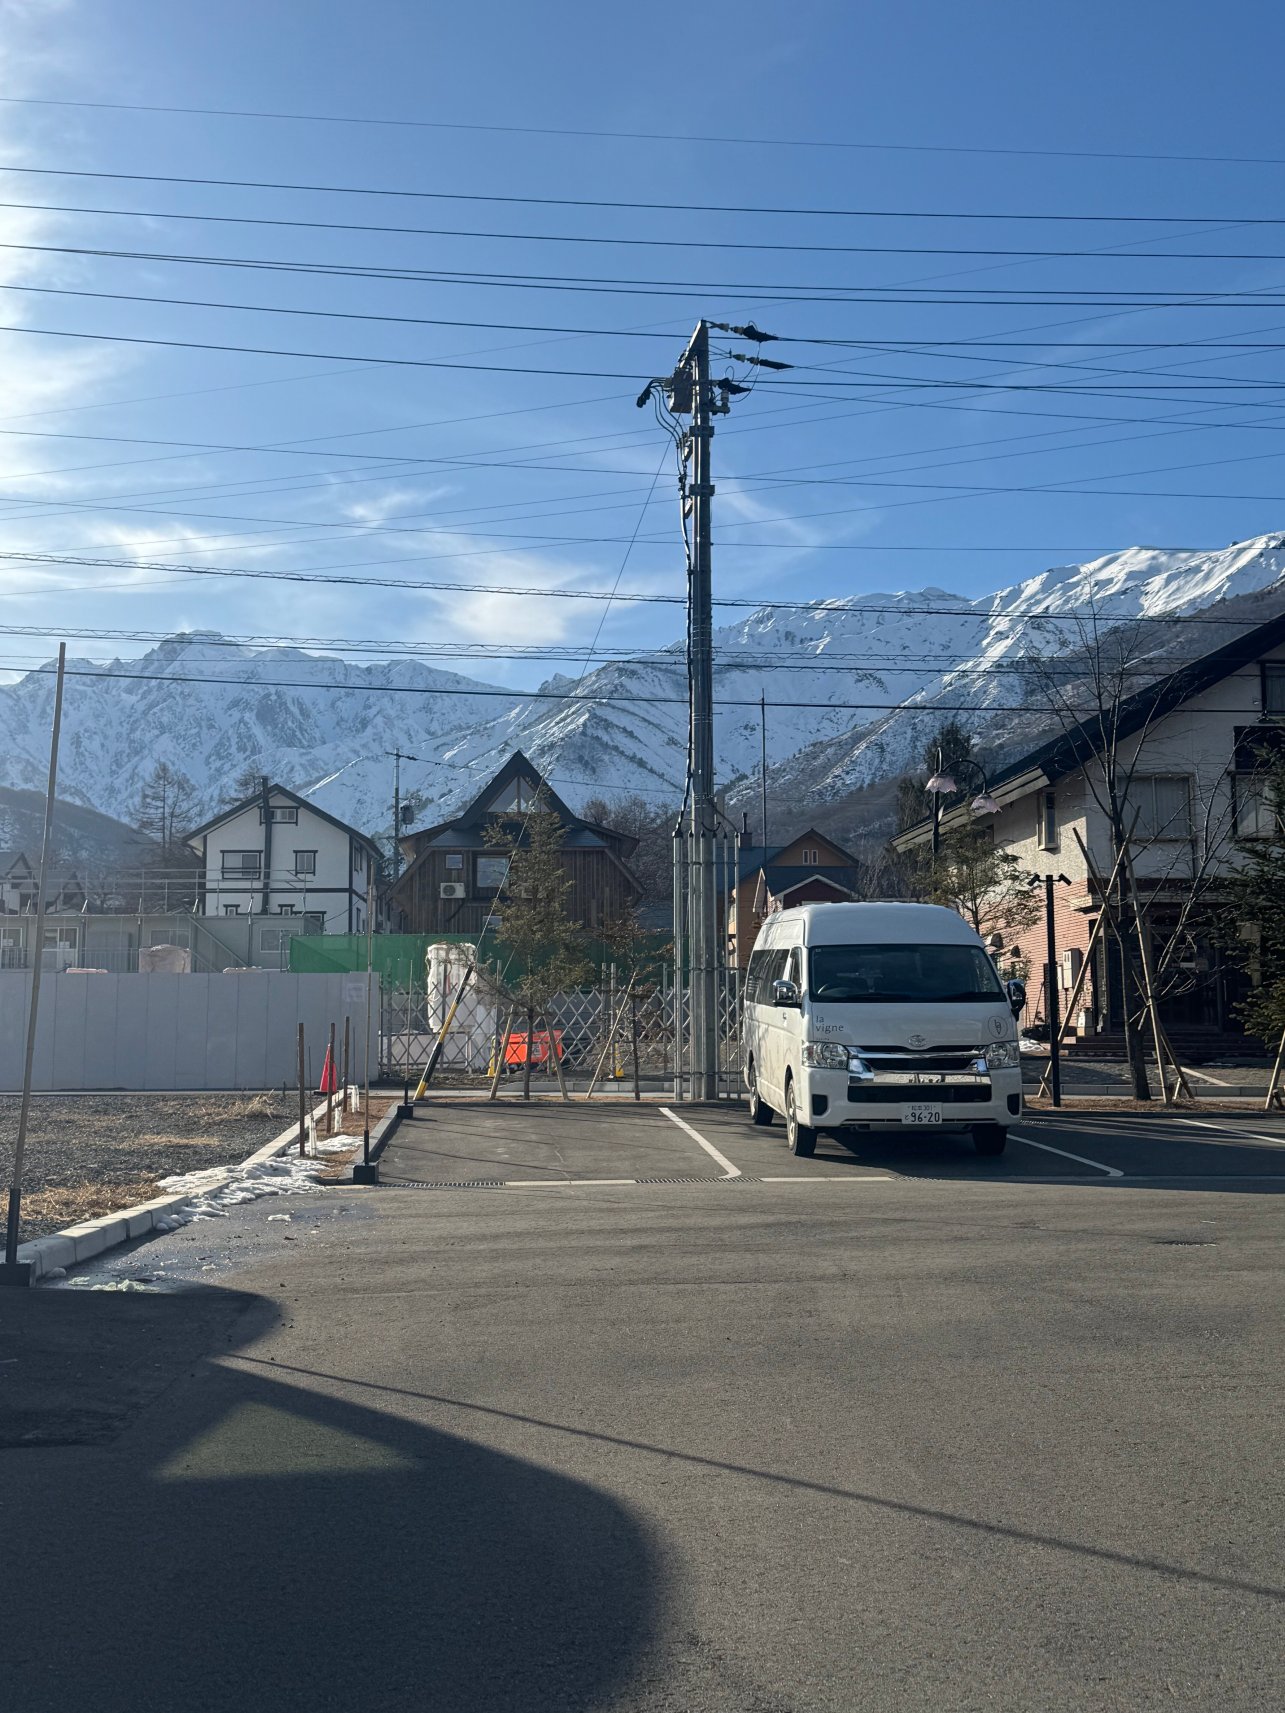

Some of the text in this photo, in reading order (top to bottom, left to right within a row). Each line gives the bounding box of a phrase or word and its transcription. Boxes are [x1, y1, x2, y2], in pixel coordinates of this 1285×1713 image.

[816, 1015, 825, 1023] la
[815, 1023, 844, 1034] vigne
[911, 1111, 940, 1123] 96-20
